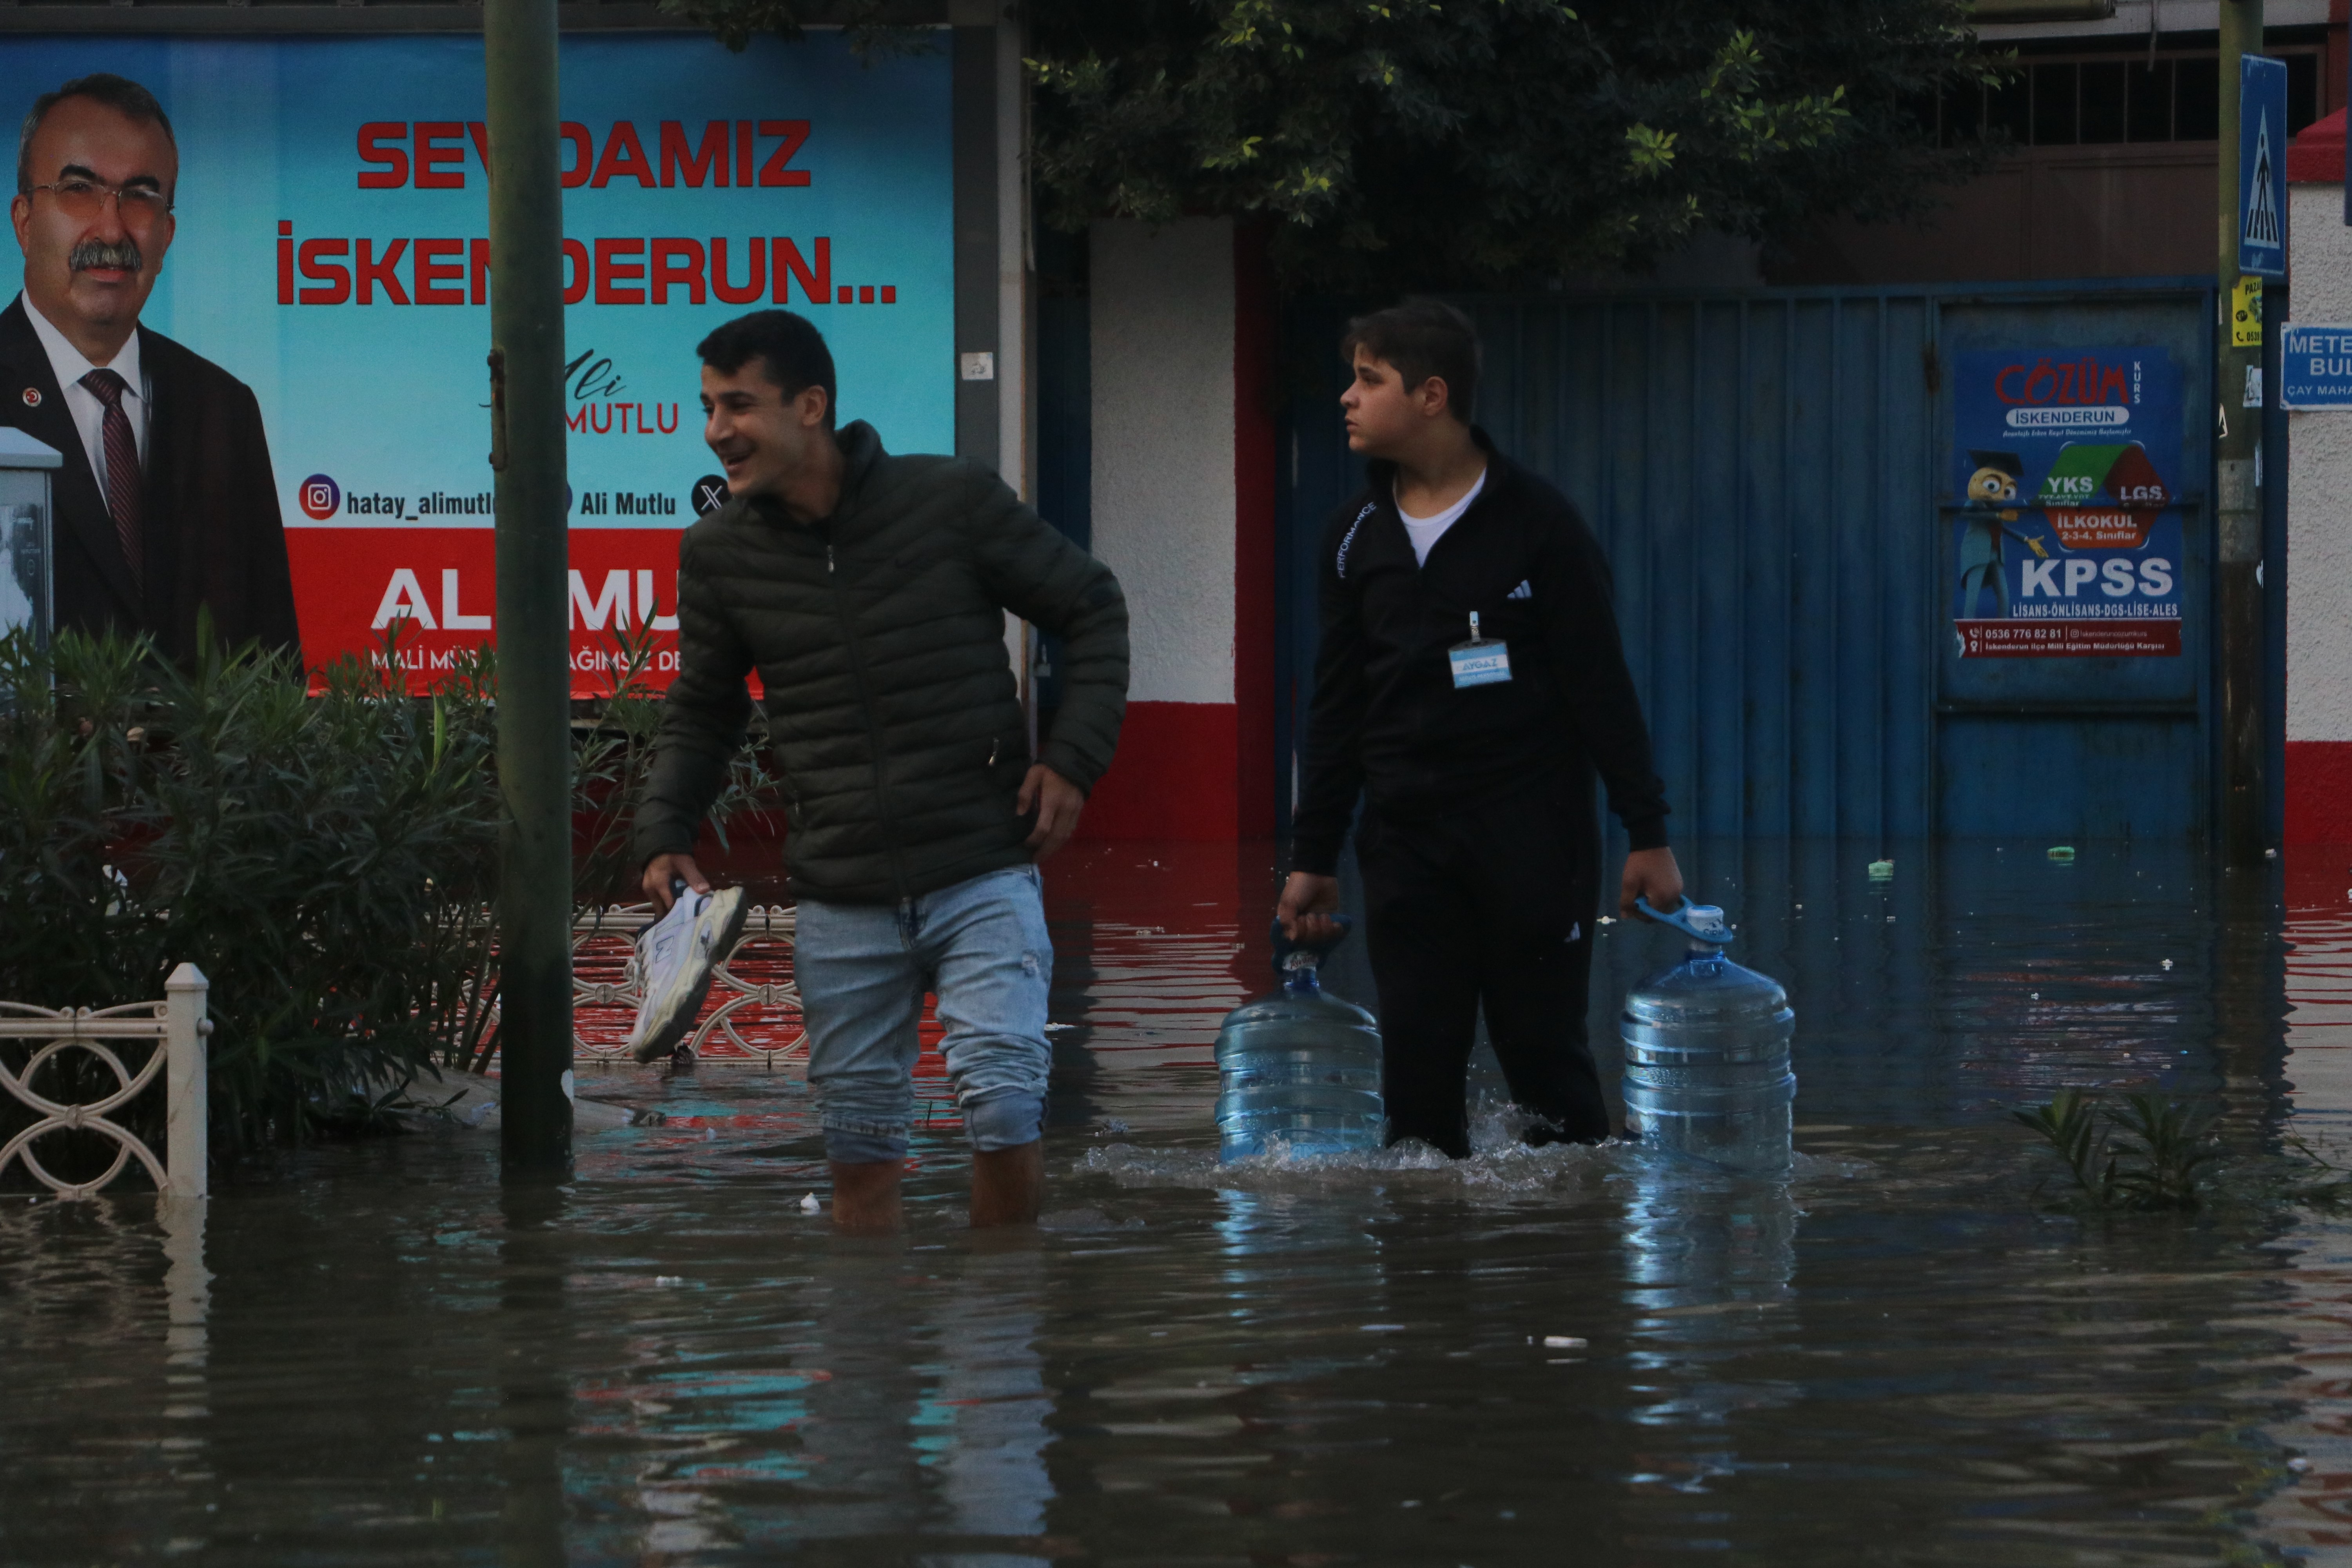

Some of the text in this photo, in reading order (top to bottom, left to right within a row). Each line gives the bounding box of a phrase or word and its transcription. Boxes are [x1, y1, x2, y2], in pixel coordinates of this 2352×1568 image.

[2289, 335, 2352, 354] METE
[2287, 385, 2312, 397] ÇAY
[565, 403, 678, 434] MUTLU
[2016, 410, 2115, 425] İSKENDERUN
[2047, 476, 2093, 493] YKS
[581, 493, 675, 515] Ali Mutlu
[2058, 513, 2137, 529] İLKOKUL
[1336, 502, 1377, 579] PERFORMANCE
[2096, 531, 2136, 540] Sınıflar
[2022, 557, 2173, 597] KPSS
[1985, 628, 2061, 639] 0536 776 82 81
